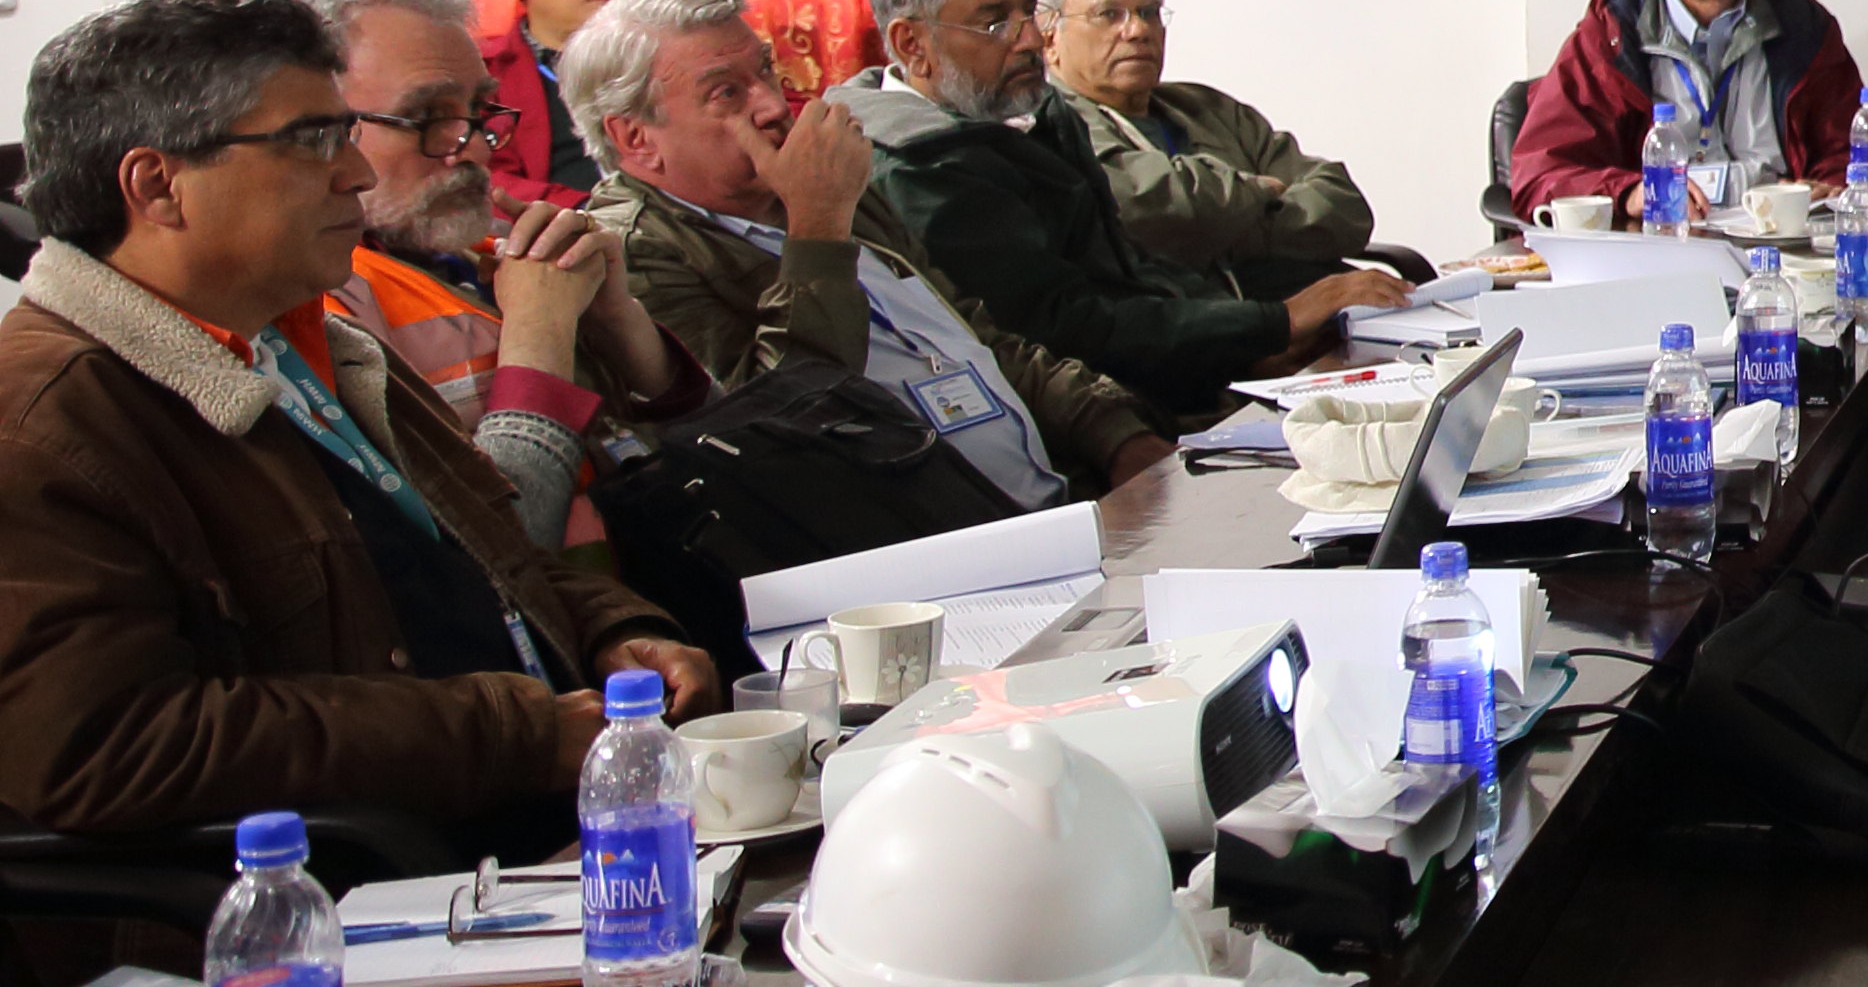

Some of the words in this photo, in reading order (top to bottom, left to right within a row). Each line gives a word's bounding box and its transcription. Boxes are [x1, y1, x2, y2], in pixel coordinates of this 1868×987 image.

[1743, 353, 1797, 385] AQUAFINA
[1652, 441, 1713, 479] AQUAFINA
[582, 861, 667, 915] QUAFINA
